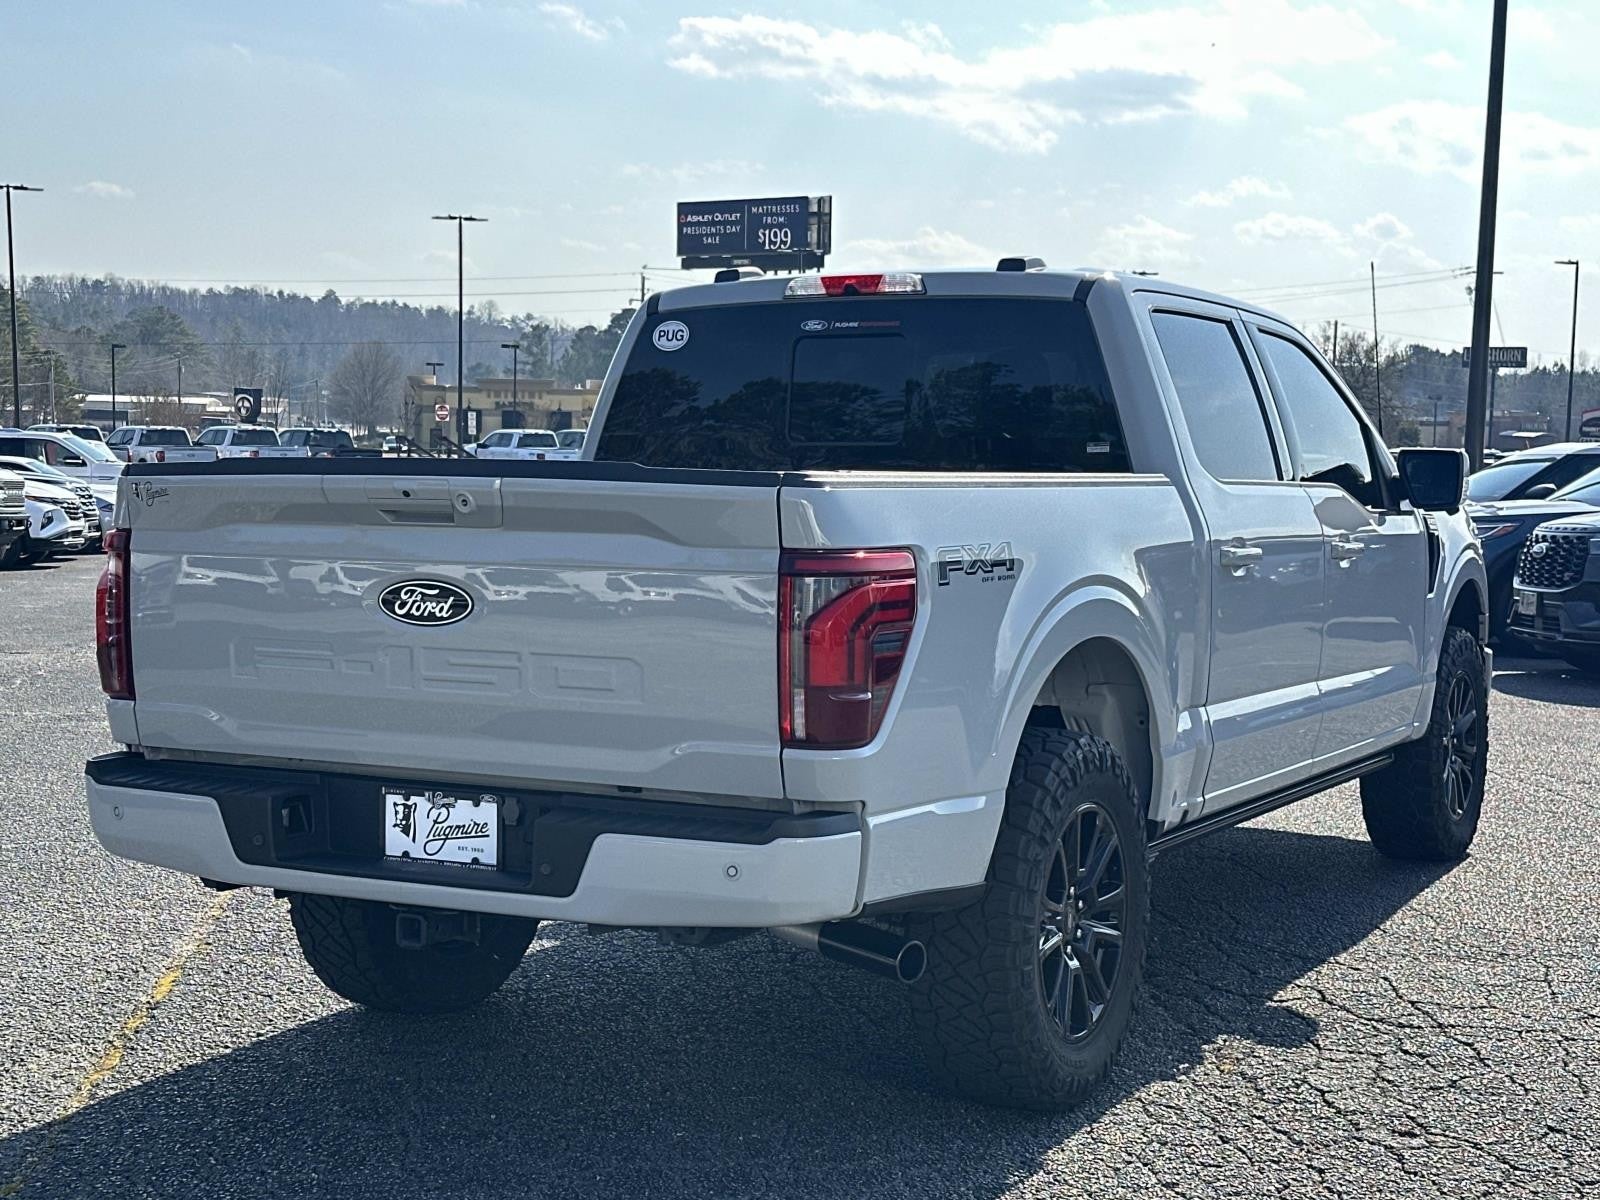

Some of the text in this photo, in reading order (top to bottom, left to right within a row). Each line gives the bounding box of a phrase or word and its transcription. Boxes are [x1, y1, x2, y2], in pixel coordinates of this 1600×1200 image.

[686, 212, 741, 222] ASHLEY OUTLET
[751, 204, 800, 214] MATTRESSES
[762, 216, 788, 224] FROM:
[683, 225, 741, 234] PRESIDENTS DAY
[702, 235, 720, 244] SALE
[758, 228, 791, 250] $199
[657, 321, 685, 343] PUG
[1464, 348, 1521, 361] LHORN
[936, 541, 1015, 586] FX4
[394, 586, 453, 619] Ford
[229, 636, 646, 705] F-150
[423, 804, 490, 856] Pugmire
